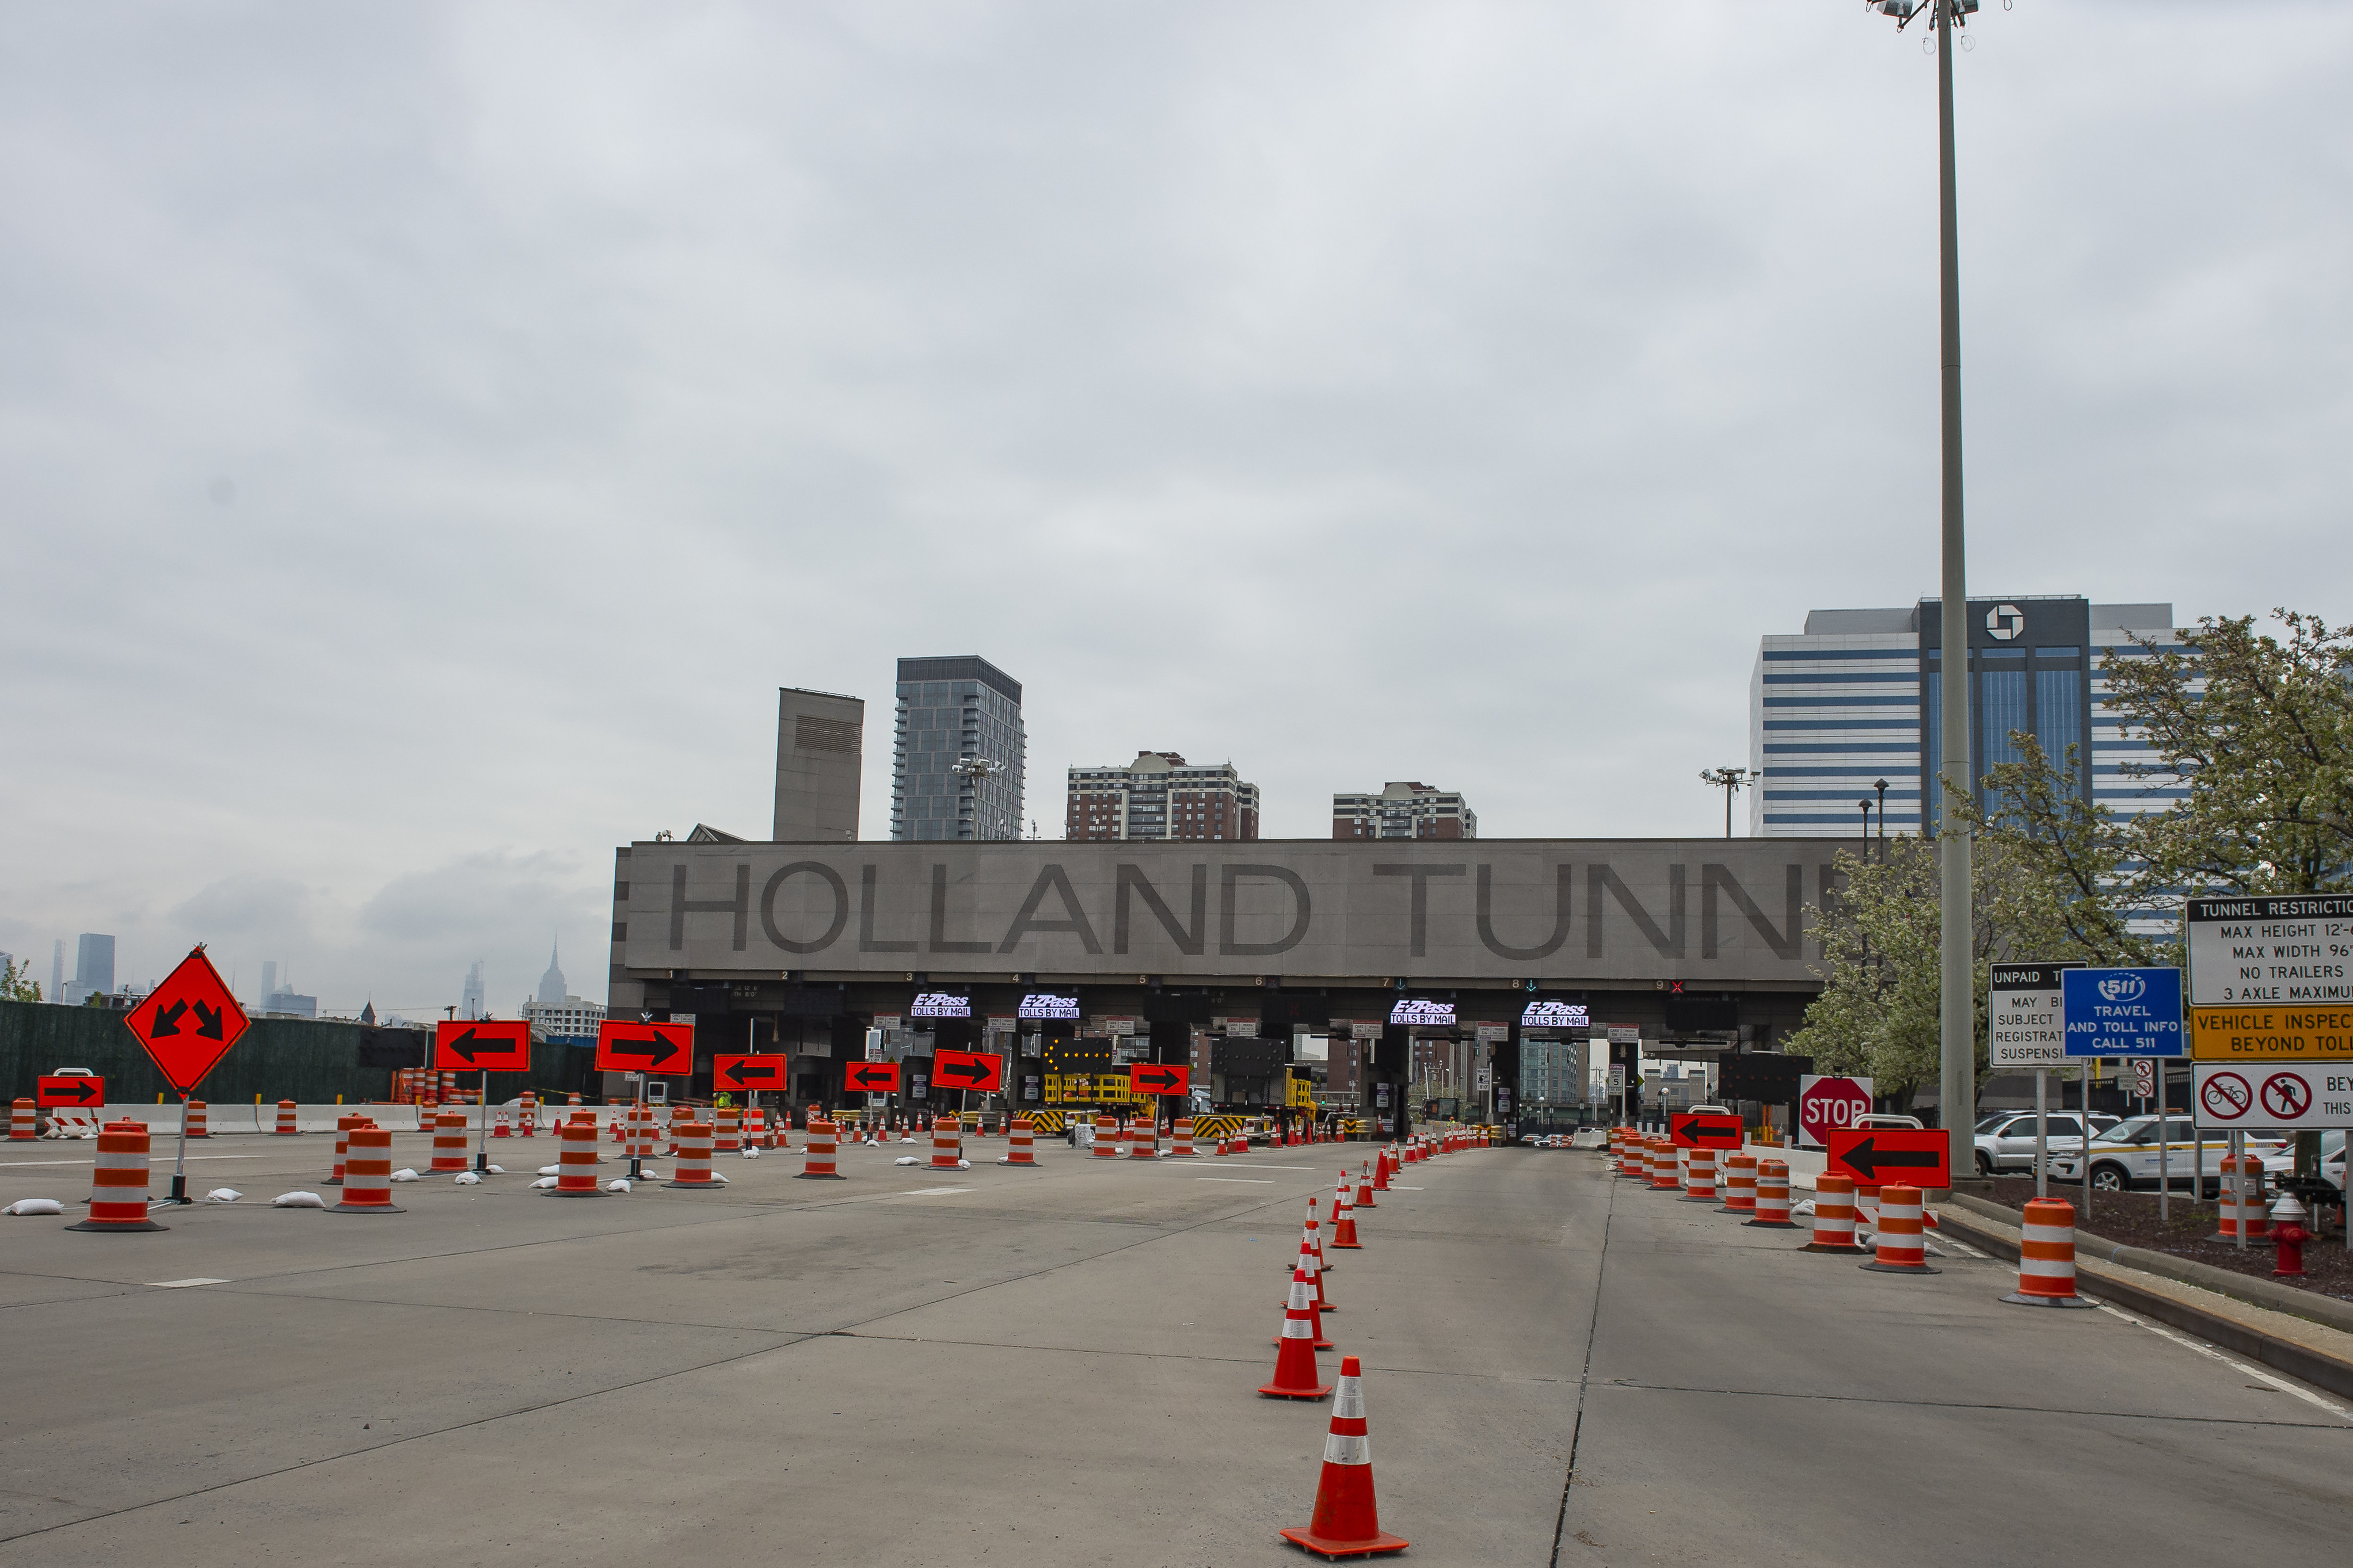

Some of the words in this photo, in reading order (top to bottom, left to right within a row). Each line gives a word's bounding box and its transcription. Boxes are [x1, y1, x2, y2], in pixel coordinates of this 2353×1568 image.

[669, 861, 1311, 956] HOLLAND
[1373, 863, 1880, 961] TUNNE
[2200, 903, 2261, 917] TUNNEL
[2221, 926, 2253, 938] MAX
[2261, 924, 2316, 937] HEIGHT
[2232, 946, 2265, 959] MAX
[2274, 945, 2320, 958] WIDTH
[669, 970, 673, 978] 1
[1994, 971, 2040, 983] UNPAID
[2240, 967, 2261, 979] NO
[2268, 965, 2344, 978] TRAILERS
[1012, 974, 1019, 982] 4
[1139, 975, 1146, 983] 5
[1255, 976, 1262, 985] 6
[1383, 978, 1389, 986] 7
[1513, 980, 1520, 988] 8
[1657, 981, 1663, 989] 9
[2107, 980, 2135, 994] 511
[2223, 987, 2233, 1000] 3
[2241, 987, 2280, 999] AXLE
[2289, 986, 2353, 998] MAXIMU
[2011, 997, 2037, 1008] MAY
[912, 1008, 935, 1016] TOLLS
[938, 1008, 948, 1016] BY
[950, 1008, 970, 1016] MAIL
[1019, 1008, 1044, 1017] TOLLS
[1046, 1008, 1057, 1017] BY
[1060, 1009, 1079, 1017] MAIL
[2094, 1006, 2151, 1016] TRAVEL
[1391, 1014, 1417, 1024] TOLLS
[1420, 1014, 1432, 1024] BY
[1434, 1015, 1456, 1024] MAIL
[1522, 1016, 1549, 1025] TOLLS
[1552, 1017, 1564, 1025] BY
[1567, 1017, 1589, 1026] MAIL
[1998, 1014, 2054, 1025] SUBJECT
[2198, 1014, 2274, 1029] VEHICLE
[2286, 1014, 2353, 1029] INSPEC
[2067, 1022, 2097, 1032] AND
[2103, 1022, 2138, 1032] TOLL
[2145, 1021, 2178, 1032] INFO
[2092, 1037, 2129, 1048] CALL
[2135, 1037, 2156, 1048] 511
[2231, 1036, 2305, 1051] BEYOND
[2000, 1048, 2073, 1059] SUSPENSI
[1806, 1098, 1865, 1125] STOP
[2324, 1102, 2351, 1115] THIS
